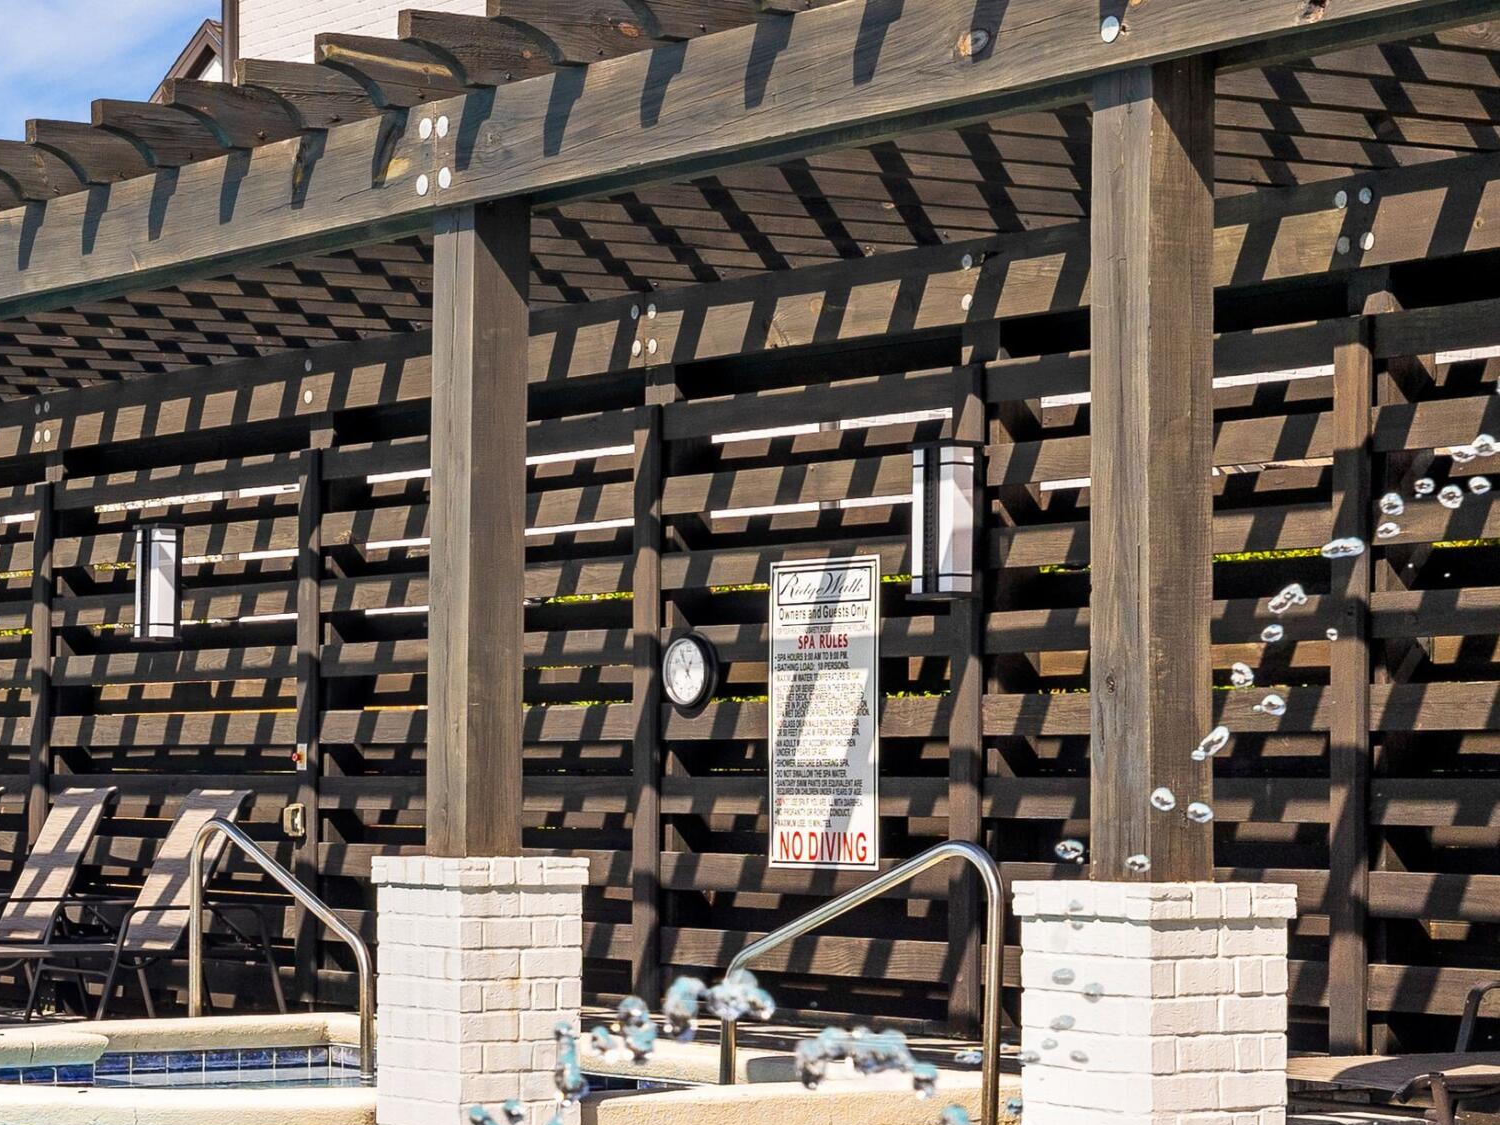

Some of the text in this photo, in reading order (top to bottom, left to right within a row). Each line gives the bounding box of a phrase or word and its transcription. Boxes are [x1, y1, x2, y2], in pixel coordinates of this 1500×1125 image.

[779, 604, 869, 620] Owners and Guests Only
[798, 634, 848, 649] SPA RULES
[777, 653, 786, 661] SPA
[787, 652, 803, 660] HOURS
[777, 662, 799, 671] BATHING
[780, 831, 867, 862] NO DIVING
